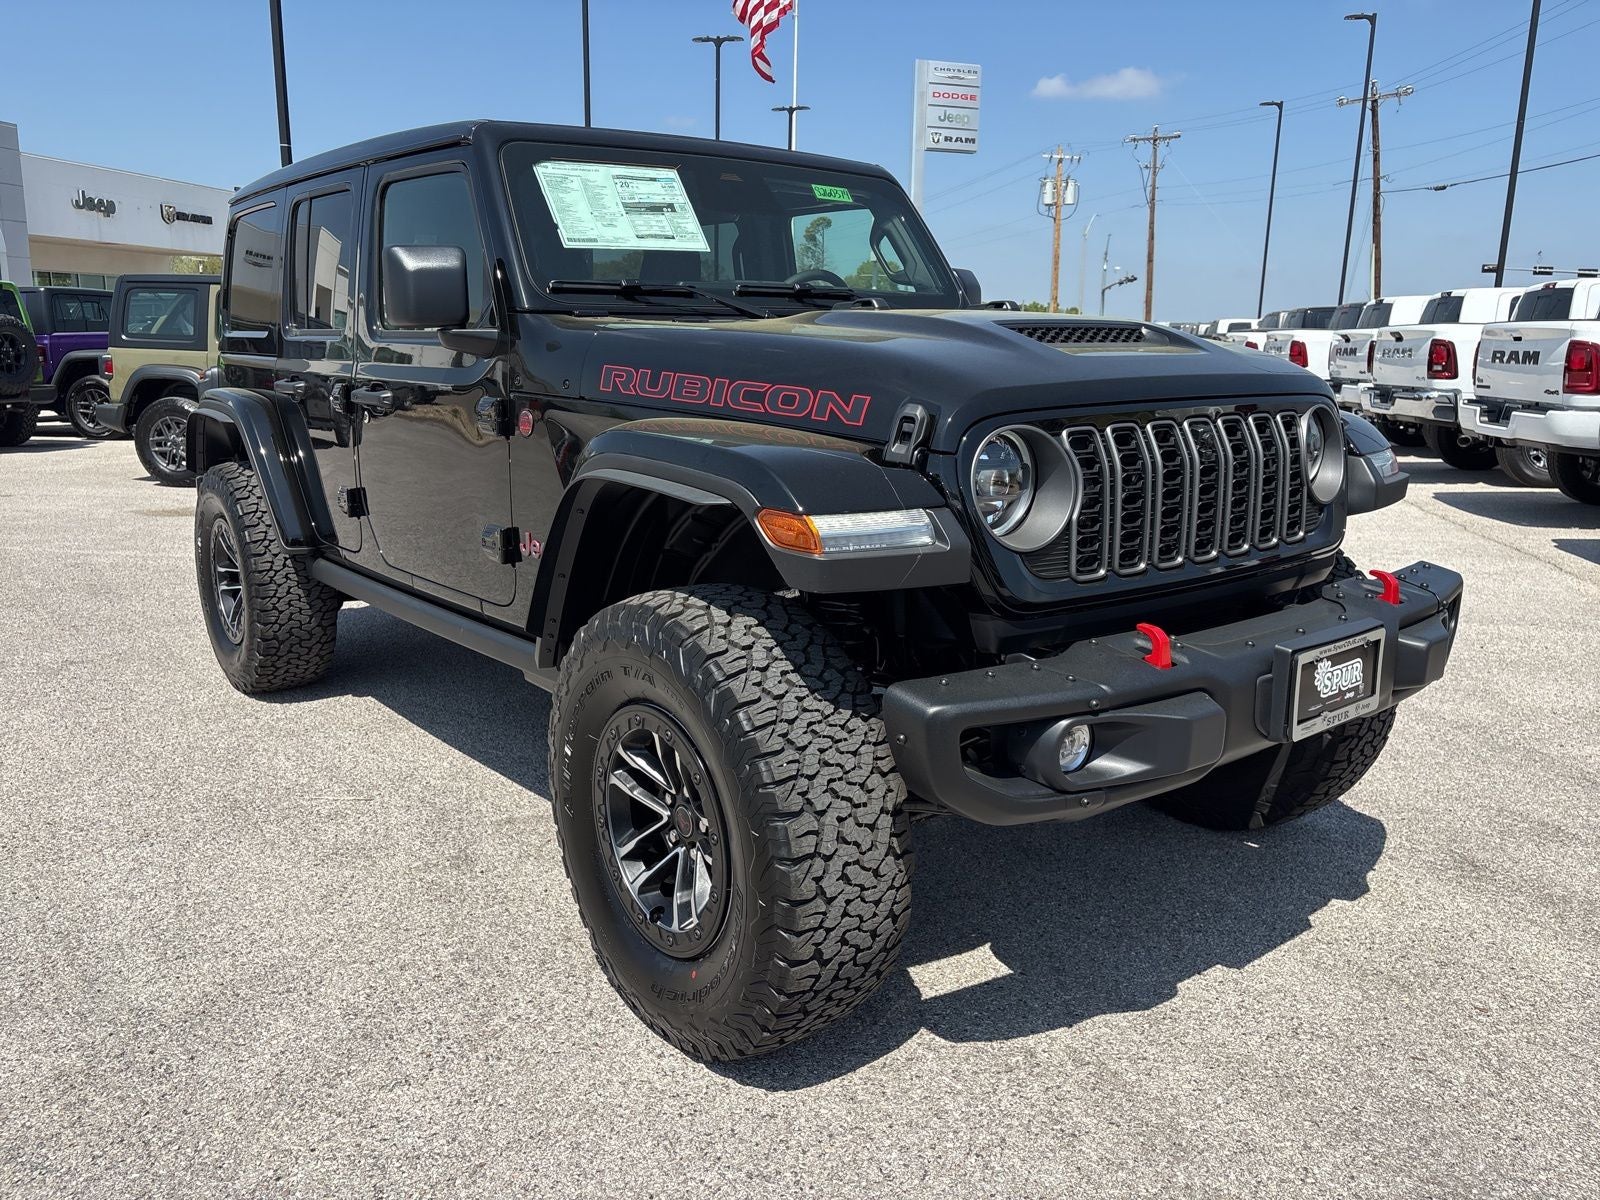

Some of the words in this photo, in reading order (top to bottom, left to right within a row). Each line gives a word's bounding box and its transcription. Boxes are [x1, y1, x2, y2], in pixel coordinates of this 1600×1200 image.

[934, 66, 978, 75] CHRYSLER
[932, 91, 977, 101] DODGE
[938, 109, 970, 127] Jeep
[944, 136, 976, 144] RAM
[71, 189, 116, 217] Jeep
[1335, 347, 1357, 357] RAM
[1382, 347, 1413, 358] RAM
[1491, 350, 1541, 366] RAM
[599, 364, 872, 426] RUBICON
[520, 531, 545, 560] Je
[1322, 661, 1362, 696] SPUR
[1326, 710, 1350, 727] SPUR
